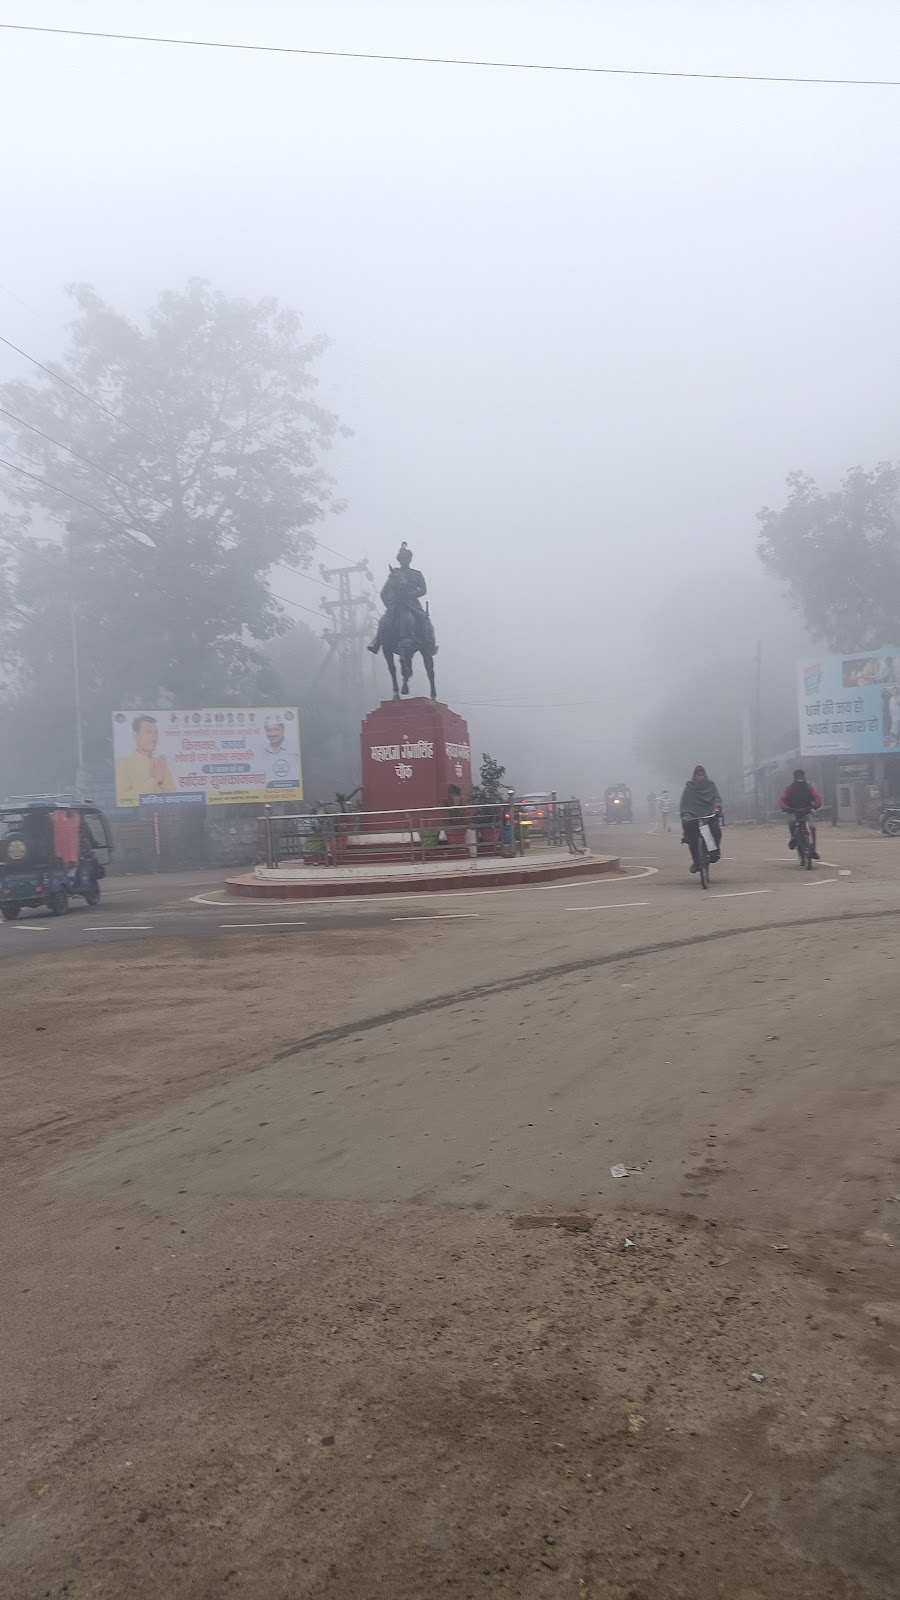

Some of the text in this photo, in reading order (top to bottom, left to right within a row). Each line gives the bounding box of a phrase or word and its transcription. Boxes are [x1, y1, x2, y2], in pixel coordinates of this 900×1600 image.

[805, 696, 864, 716] धर्म की जय हो
[807, 715, 879, 735] अधर्म का नाश हो
[370, 744, 400, 762] महाराजा
[394, 762, 413, 778] चौक
